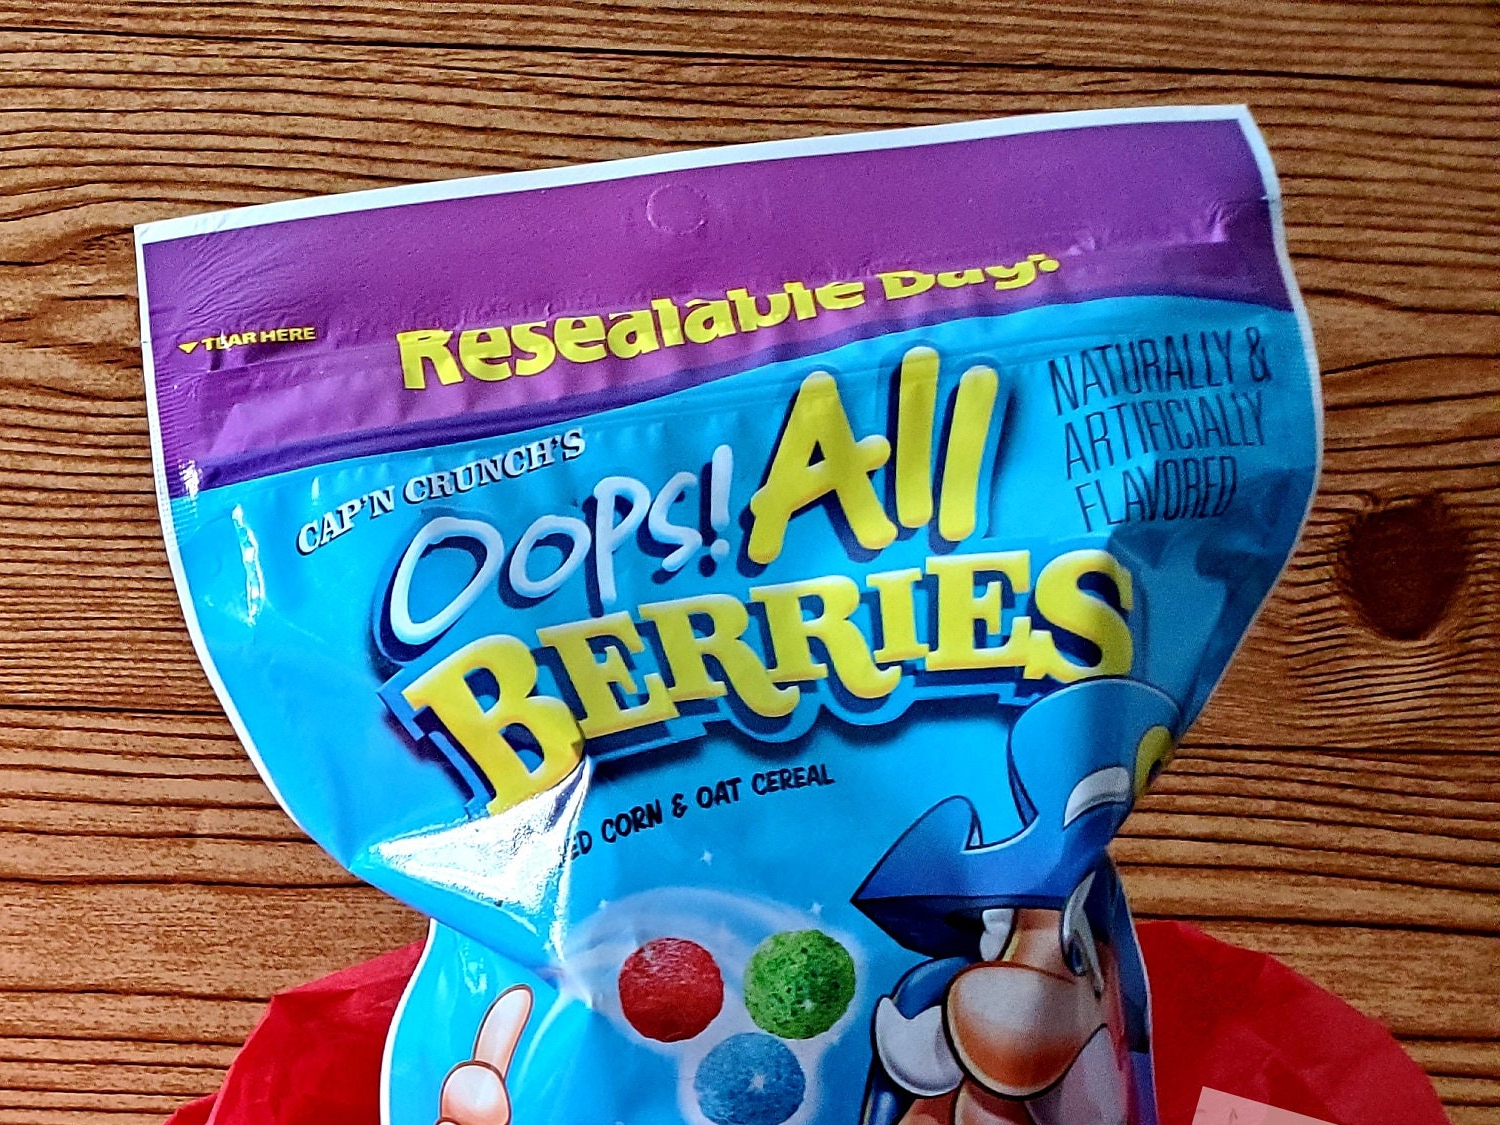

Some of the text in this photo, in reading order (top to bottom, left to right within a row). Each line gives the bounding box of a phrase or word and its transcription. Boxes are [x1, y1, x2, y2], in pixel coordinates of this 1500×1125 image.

[260, 326, 317, 343] HERE
[1047, 326, 1273, 416] NATURALLY &
[748, 346, 999, 565] All
[1064, 391, 1265, 481] ARTIFICIALLY
[296, 428, 587, 556] CAP'N CRUNCH'S
[1074, 456, 1238, 533] FLAVORED
[400, 549, 1136, 813] BERRIES
[600, 763, 837, 844] CORN & OAT CEREAL
